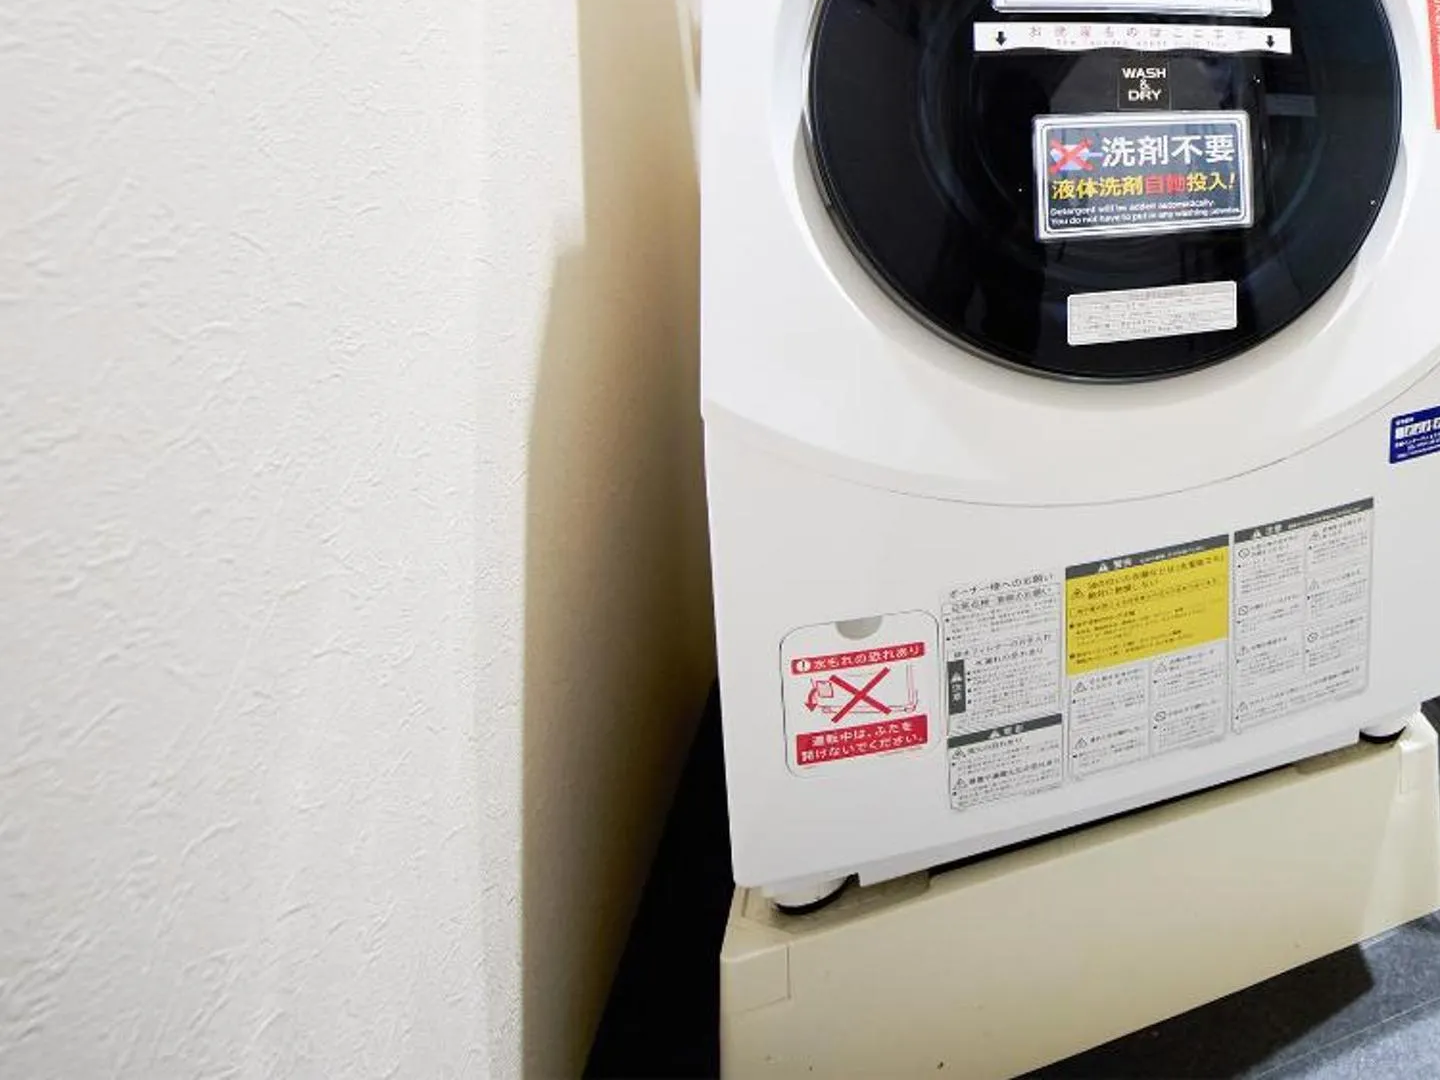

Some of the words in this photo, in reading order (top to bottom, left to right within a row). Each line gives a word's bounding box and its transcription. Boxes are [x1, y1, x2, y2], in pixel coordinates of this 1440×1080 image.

[1122, 67, 1166, 79] WASH
[1140, 79, 1150, 90] &
[1128, 89, 1161, 102] DRY
[1102, 134, 1235, 167] 洗剤不要
[814, 645, 920, 670] 水もれの恐れあり
[811, 722, 912, 747] 運転中は、ふたを
[801, 735, 924, 761] 開けないでください。
